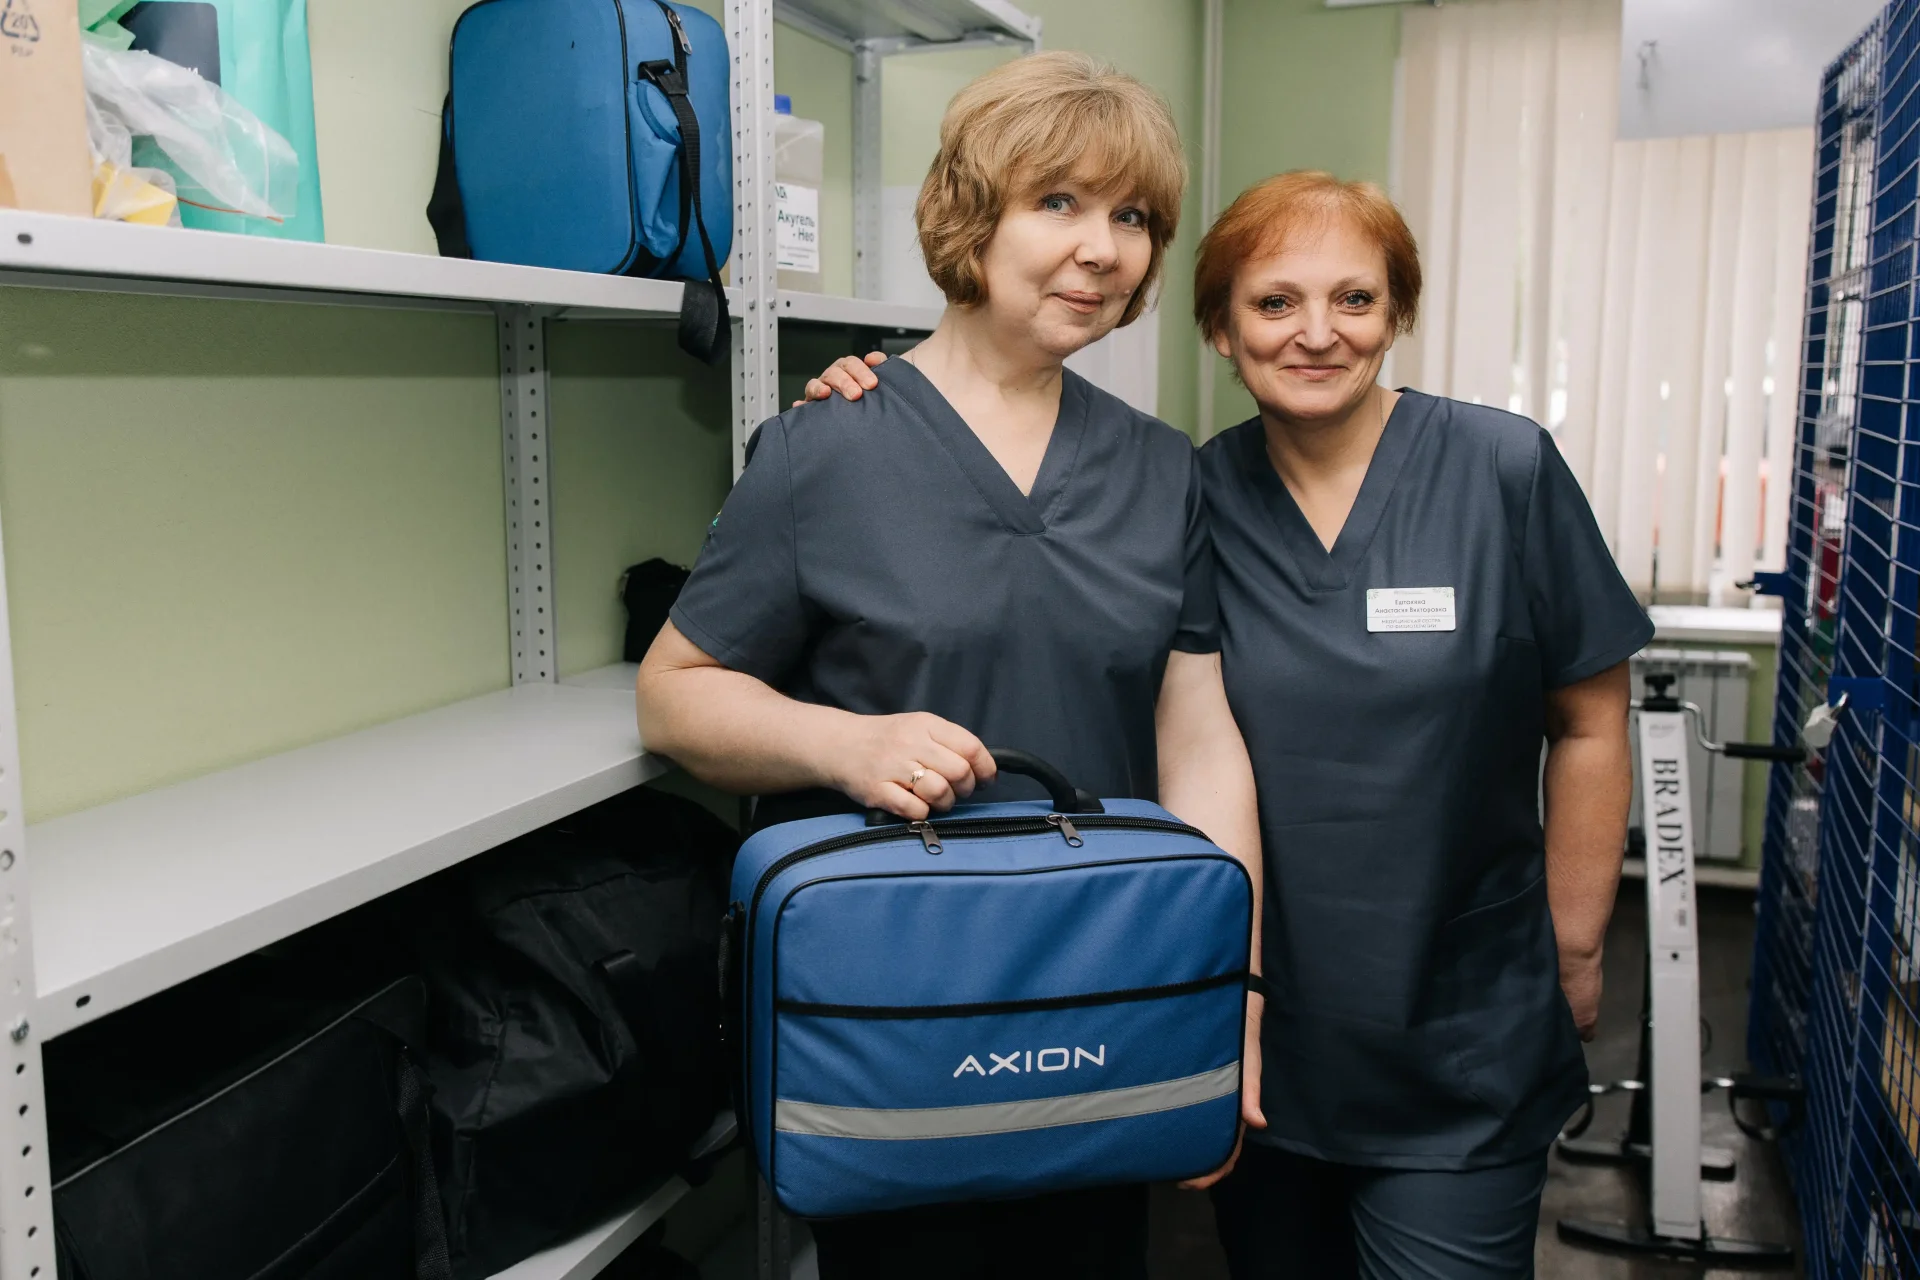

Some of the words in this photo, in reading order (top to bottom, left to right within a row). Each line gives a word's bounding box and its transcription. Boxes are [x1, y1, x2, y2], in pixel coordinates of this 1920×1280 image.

[777, 209, 815, 228] Акугель
[798, 228, 815, 242] Нео
[1409, 606, 1447, 614] Викторовна
[1652, 759, 1687, 886] BRADEX
[953, 1044, 1105, 1078] AXION
